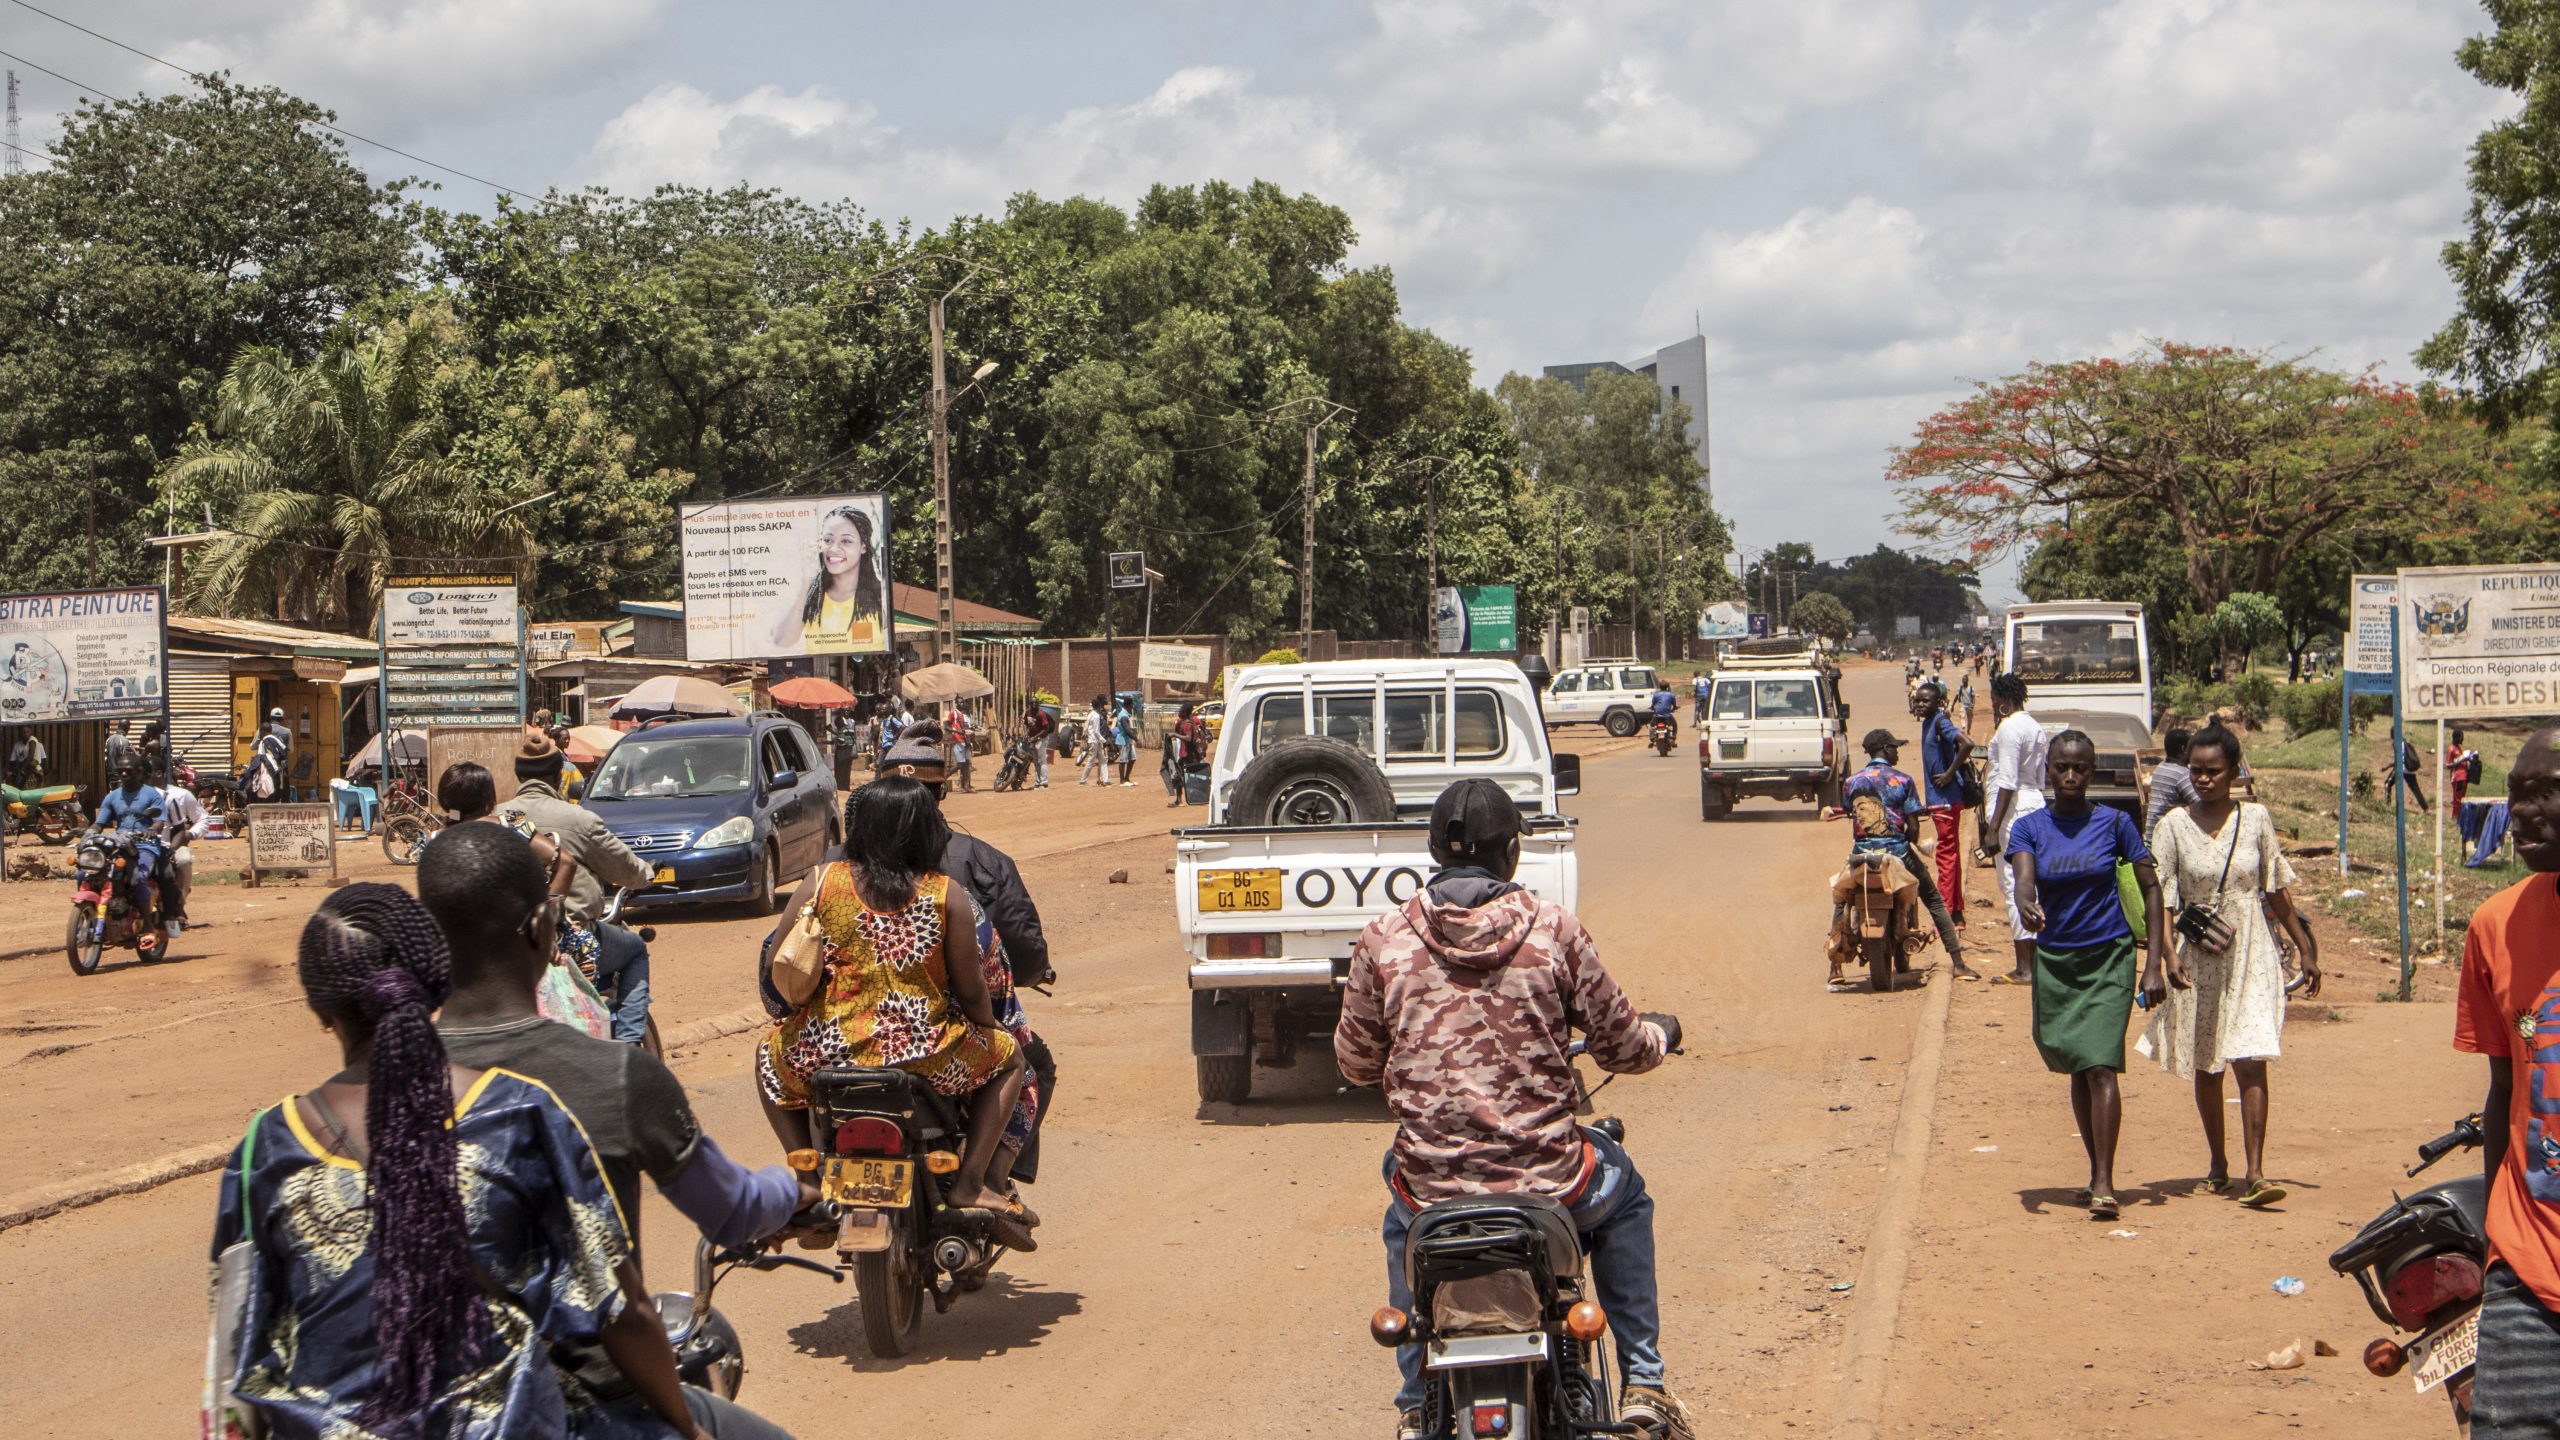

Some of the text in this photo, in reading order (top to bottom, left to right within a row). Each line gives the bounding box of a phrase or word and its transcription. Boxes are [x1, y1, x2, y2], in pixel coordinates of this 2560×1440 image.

[707, 513, 737, 524] simple
[740, 511, 763, 520] avec
[766, 510, 774, 519] le
[777, 509, 795, 518] tout
[685, 522, 792, 536] Nouveaux pass SAKPA
[695, 549, 717, 559] partir
[719, 548, 730, 556] de
[732, 547, 746, 555] 100
[748, 546, 770, 555] FCFA
[687, 571, 716, 580] Appels
[718, 570, 726, 578] et
[728, 569, 747, 577] SMS
[688, 582, 706, 590] tous
[708, 581, 720, 589] les
[768, 577, 790, 587] RCA,
[437, 592, 498, 603] Longrich
[688, 589, 779, 601] Internet mobile inclus.
[59, 592, 155, 617] PEINTURE
[419, 606, 488, 615] Better Life, Better Future
[391, 619, 435, 628] www.longrich.cf
[2491, 616, 2545, 630] MINISTERE
[551, 630, 576, 640] Elan
[2483, 637, 2530, 651] DIRECTION
[388, 651, 434, 660] MAINTENANCE
[435, 651, 481, 659] INFORMATIQUE
[2431, 663, 2484, 675] Direction
[2487, 661, 2547, 677] Régionale
[388, 672, 420, 681] CREATION
[427, 672, 475, 681] HEBERGEMENT
[476, 672, 485, 680] DE
[486, 672, 500, 680] SITE
[501, 671, 516, 680] WEB
[431, 694, 441, 702] DE
[458, 694, 473, 702] CLIP
[2417, 681, 2500, 708] CENTRE
[2506, 680, 2547, 705] DES
[436, 715, 480, 725] PHOTOCOPIE,
[480, 714, 516, 723] SCANNAGE
[287, 810, 321, 823] DIVIN
[2048, 852, 2096, 874] NIKE
[1234, 871, 1251, 888] BG
[1280, 866, 1442, 908] OYO
[1218, 890, 1270, 908] 01 ADS
[863, 1162, 882, 1179] BG
[2436, 1330, 2479, 1364] FORCE
